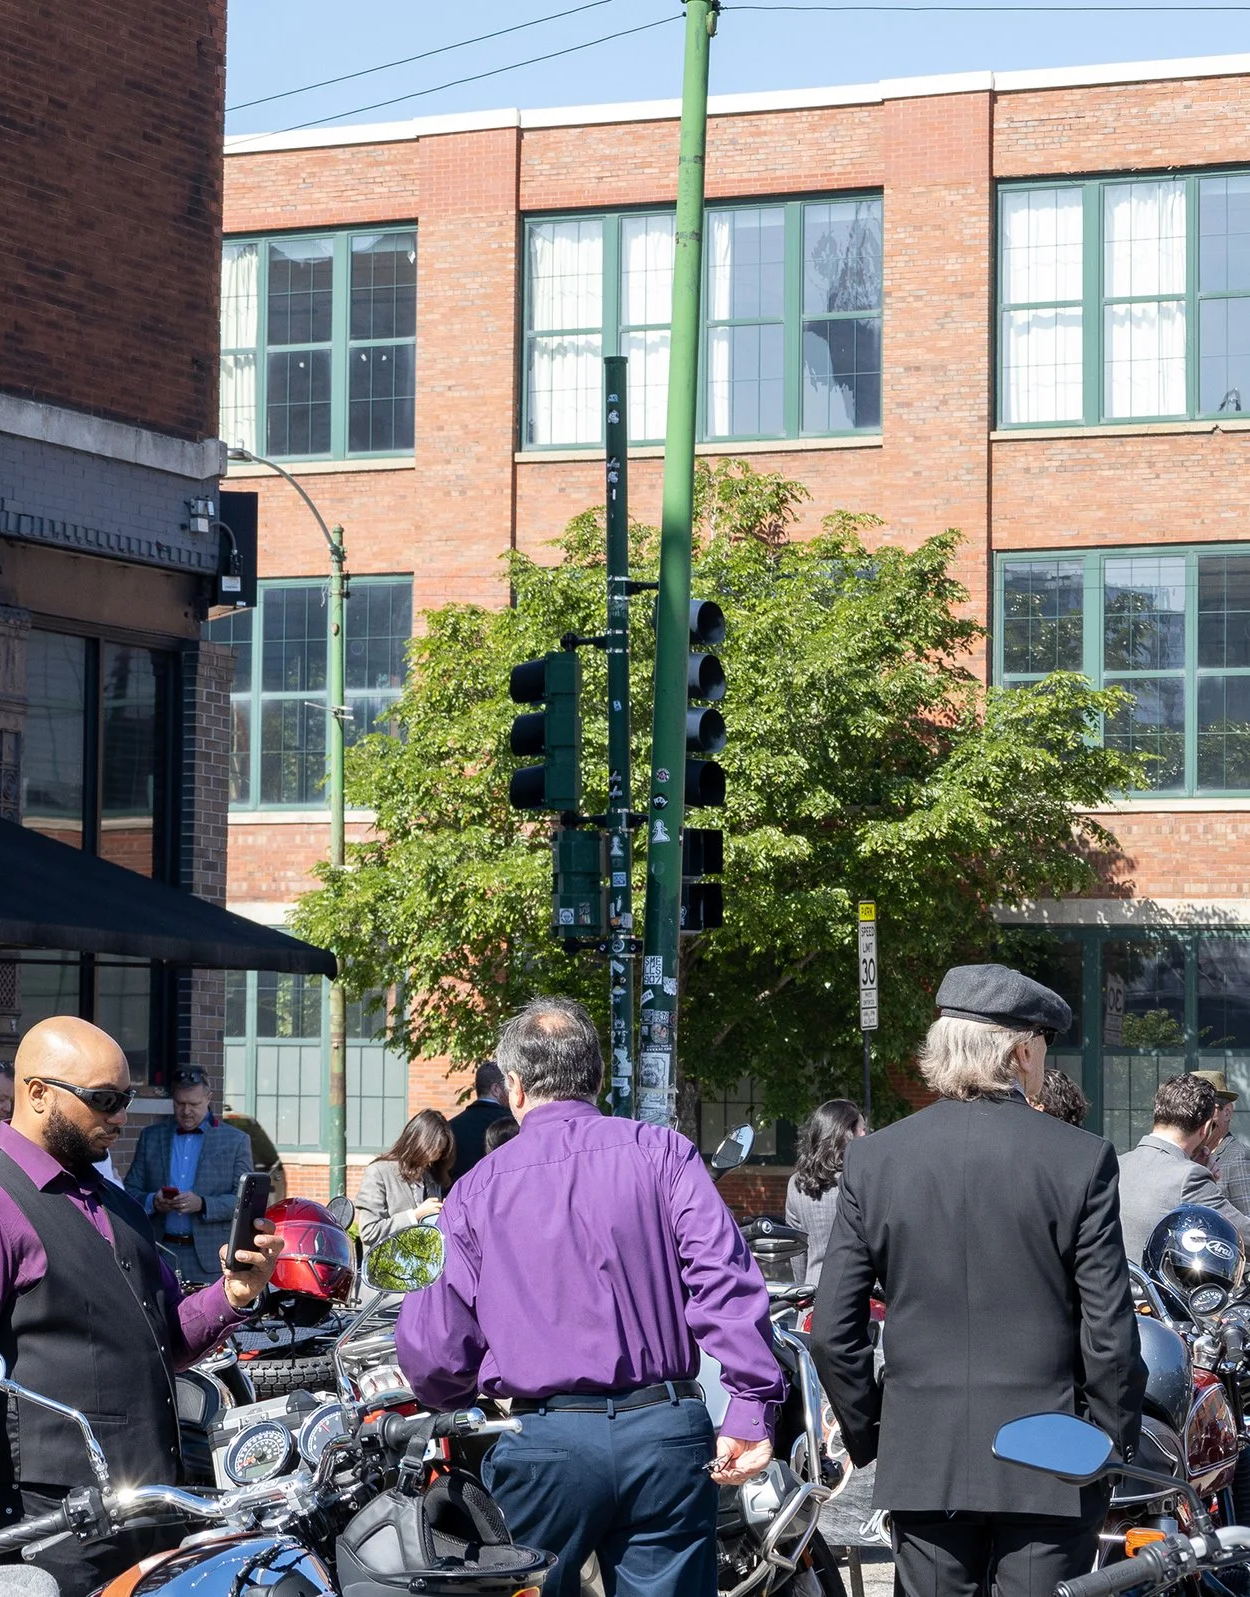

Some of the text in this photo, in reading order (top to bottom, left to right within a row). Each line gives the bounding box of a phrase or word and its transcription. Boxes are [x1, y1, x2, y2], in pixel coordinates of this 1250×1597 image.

[861, 926, 875, 937] SPEED
[862, 942, 874, 954] LIMIT
[861, 958, 876, 986] 30
